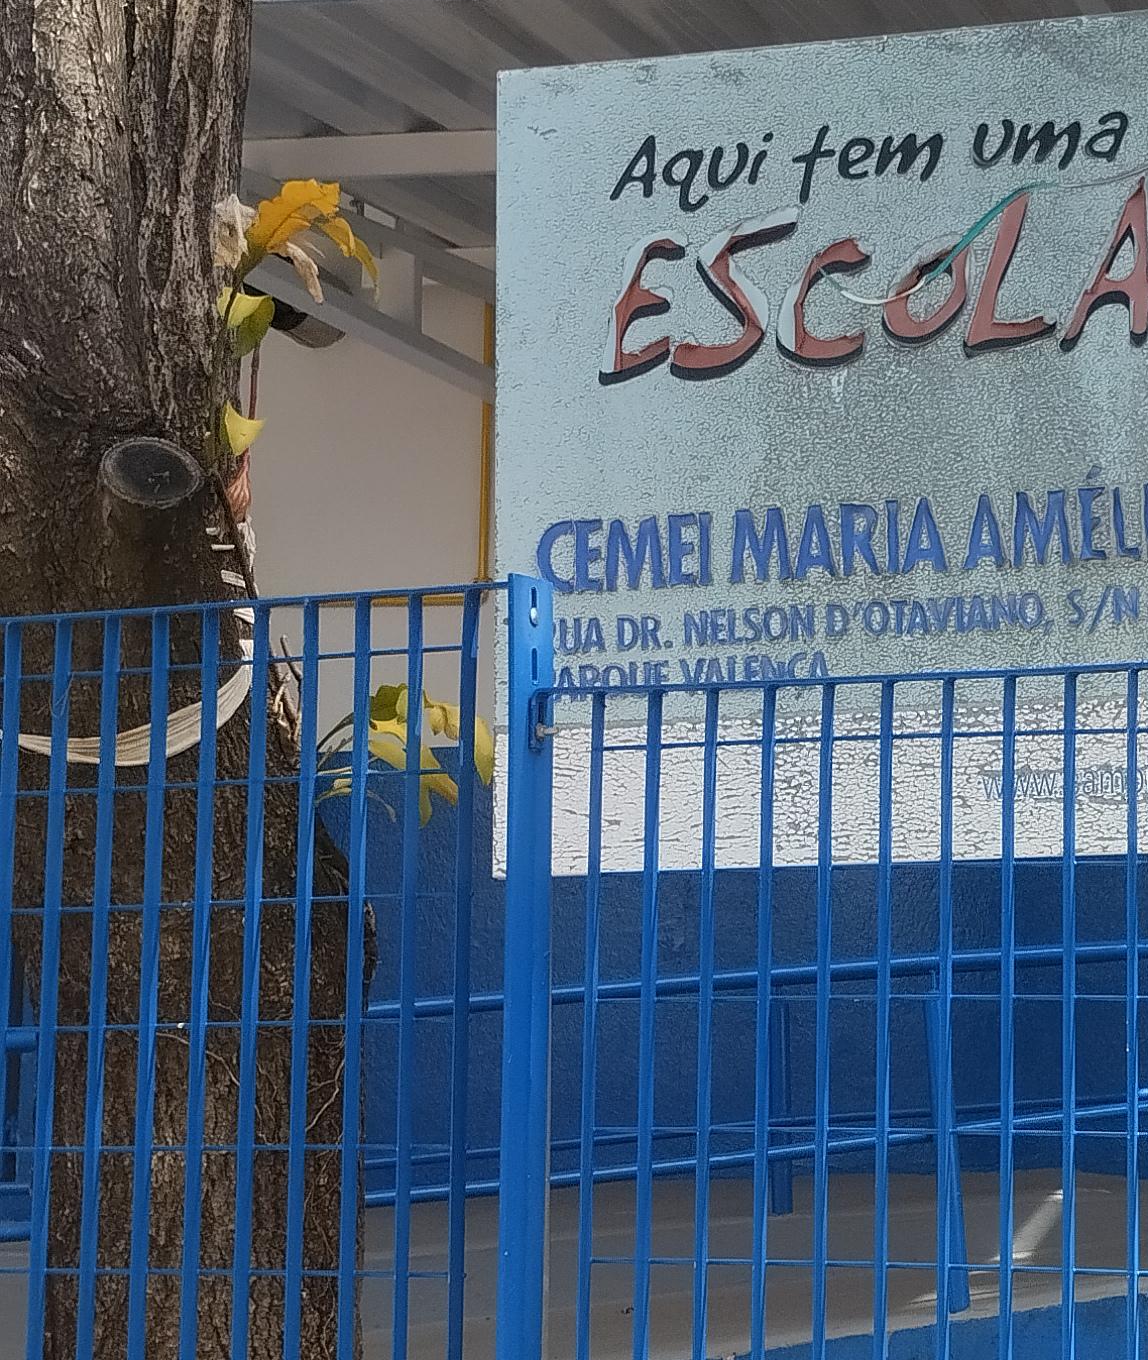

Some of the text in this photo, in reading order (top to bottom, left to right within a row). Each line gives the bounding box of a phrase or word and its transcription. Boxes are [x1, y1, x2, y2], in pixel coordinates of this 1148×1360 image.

[609, 111, 1130, 212] Aqui tem uma
[537, 512, 712, 594] CEMEI
[730, 497, 949, 584] MARIA
[553, 616, 607, 655] UA
[616, 614, 674, 651] DR.
[683, 603, 817, 646] NELSON
[1067, 585, 1140, 635] S/N
[553, 658, 670, 702] ARQUE
